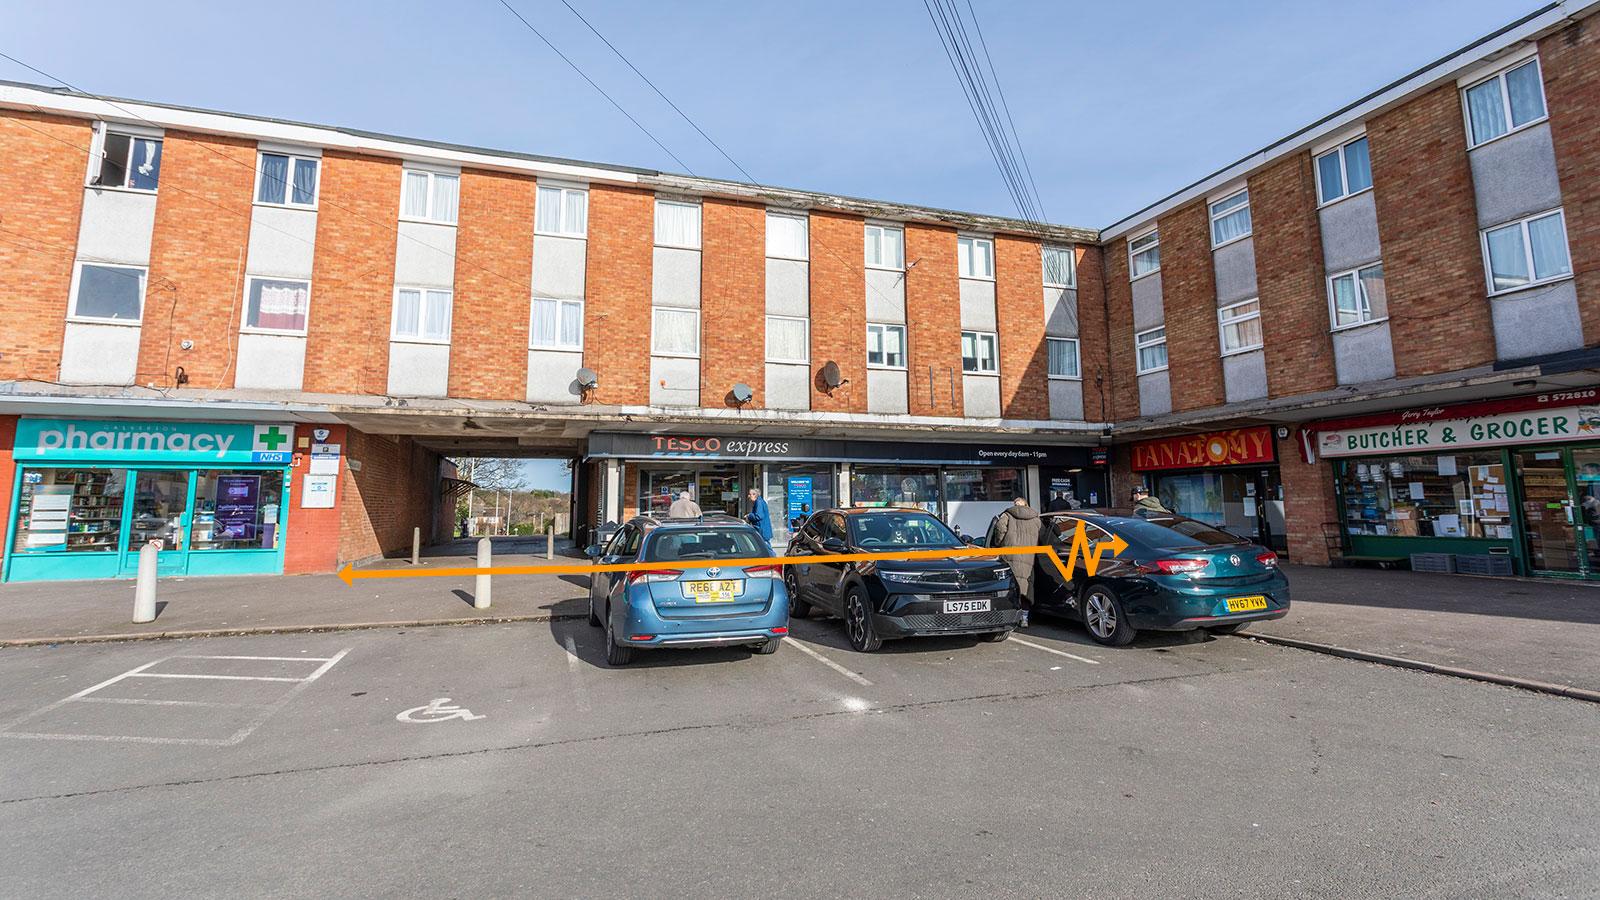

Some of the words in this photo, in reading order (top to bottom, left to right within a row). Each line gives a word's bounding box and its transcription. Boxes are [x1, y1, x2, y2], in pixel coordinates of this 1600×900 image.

[1552, 390, 1596, 401] 572810
[1423, 408, 1445, 417] Taylor
[1347, 428, 1429, 450] BUTCHER
[1441, 427, 1457, 443] &
[1470, 416, 1569, 441] GROCER
[36, 424, 235, 458] pharmacy
[652, 437, 721, 452] TESCO
[726, 440, 789, 457] express
[259, 453, 283, 461] NHS
[978, 450, 993, 458] Open
[994, 451, 1007, 459] every
[1034, 451, 1048, 459] 11pm
[946, 602, 970, 612] LS75
[971, 601, 988, 611] EDK
[1228, 600, 1249, 610] HV67
